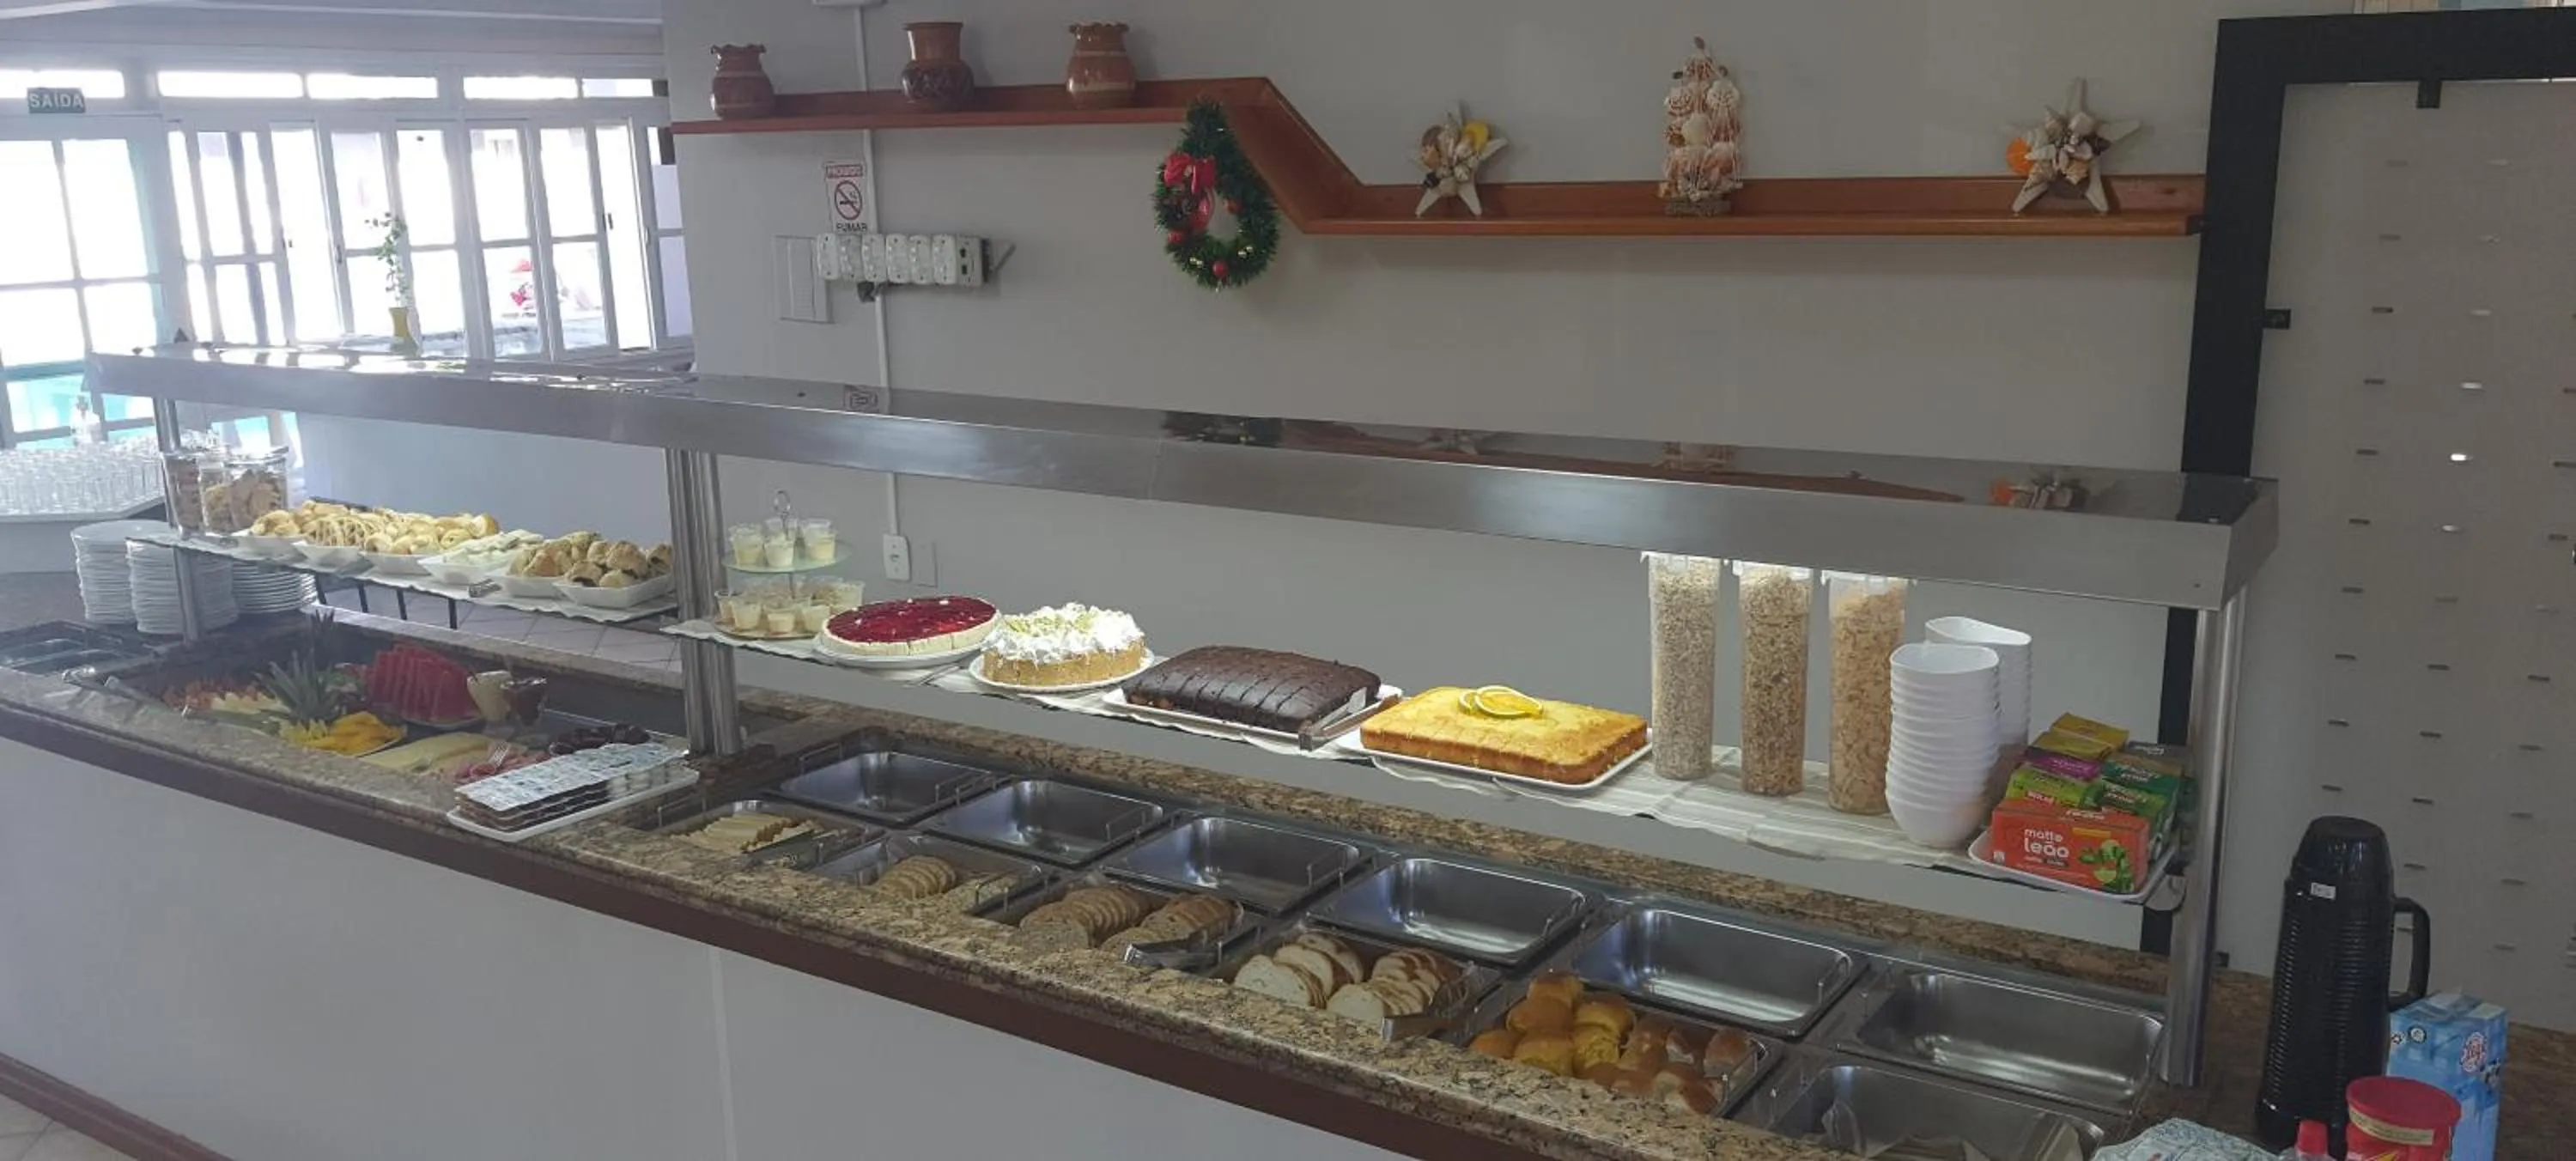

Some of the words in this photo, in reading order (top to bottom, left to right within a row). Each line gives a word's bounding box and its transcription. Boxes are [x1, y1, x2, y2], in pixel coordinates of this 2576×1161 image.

[29, 91, 84, 108] SAÍDA
[836, 222, 867, 233] FUMAR
[2023, 828, 2063, 842] matte
[2023, 837, 2069, 859] leão
